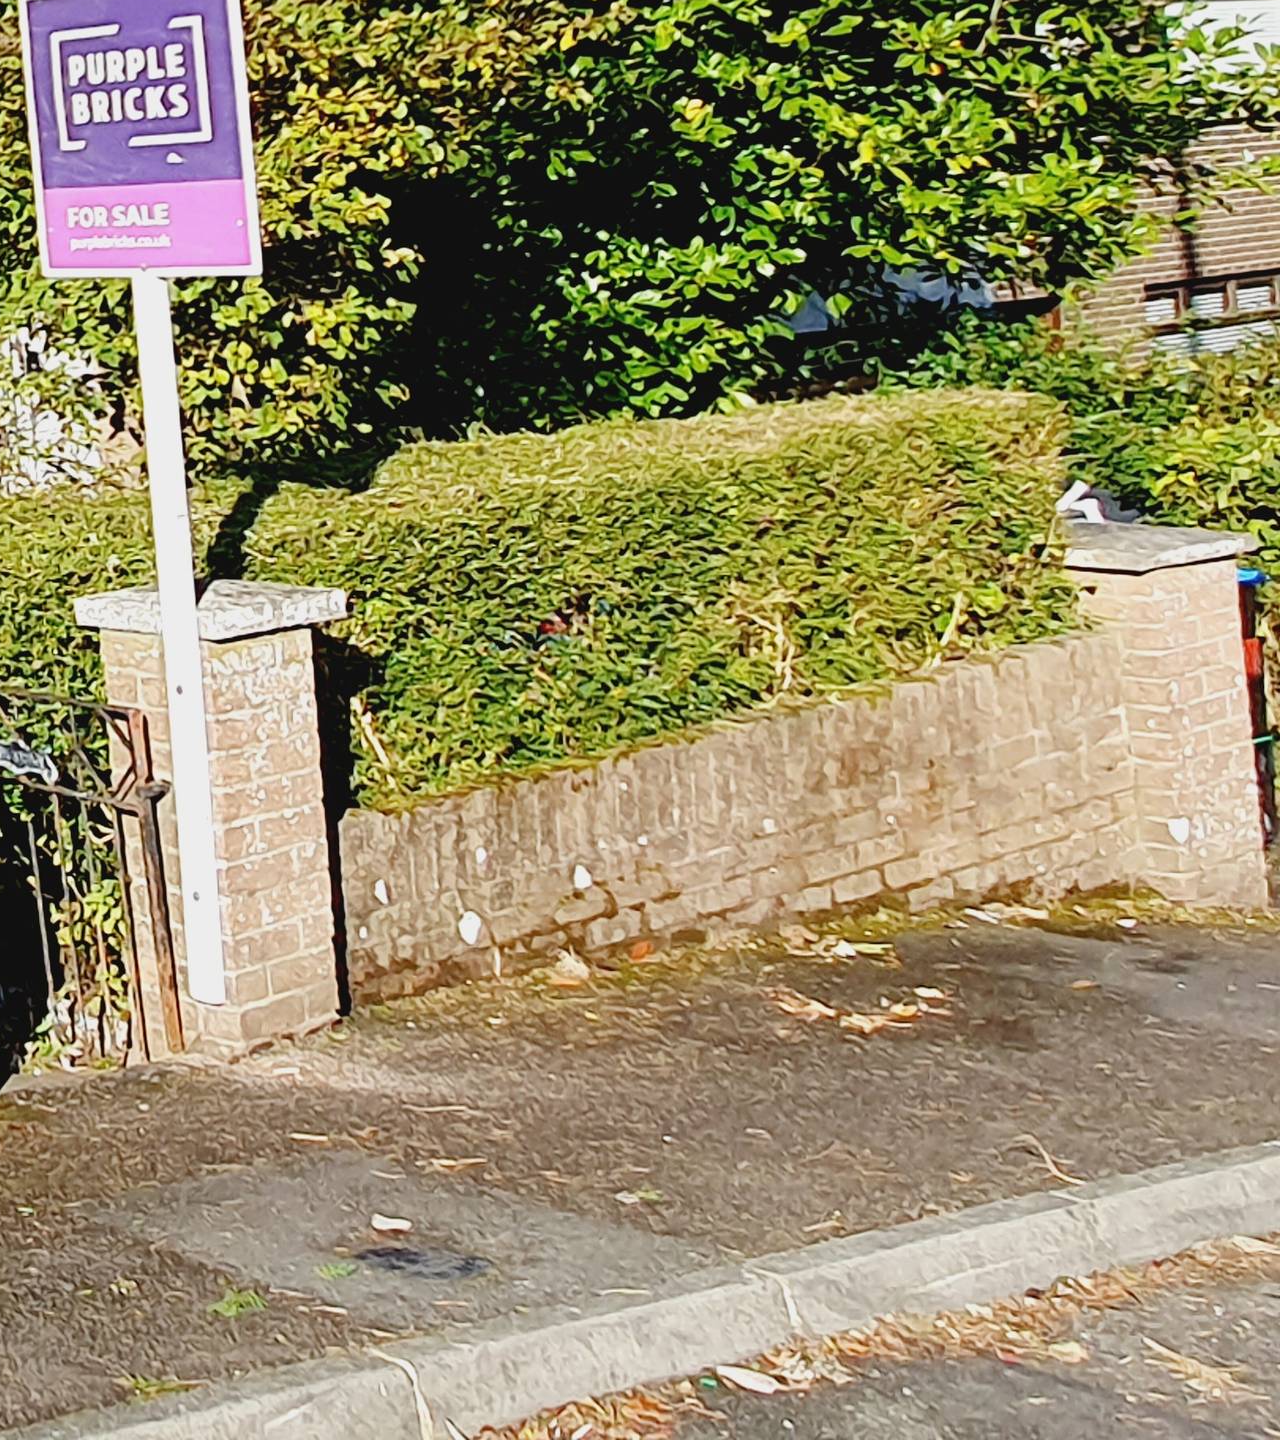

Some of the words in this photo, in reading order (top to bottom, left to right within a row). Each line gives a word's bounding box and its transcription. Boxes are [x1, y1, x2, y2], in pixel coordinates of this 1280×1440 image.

[67, 44, 185, 87] PURPLE
[72, 85, 189, 125] BRICKS
[67, 206, 109, 228] FOR
[111, 203, 170, 227] SALE
